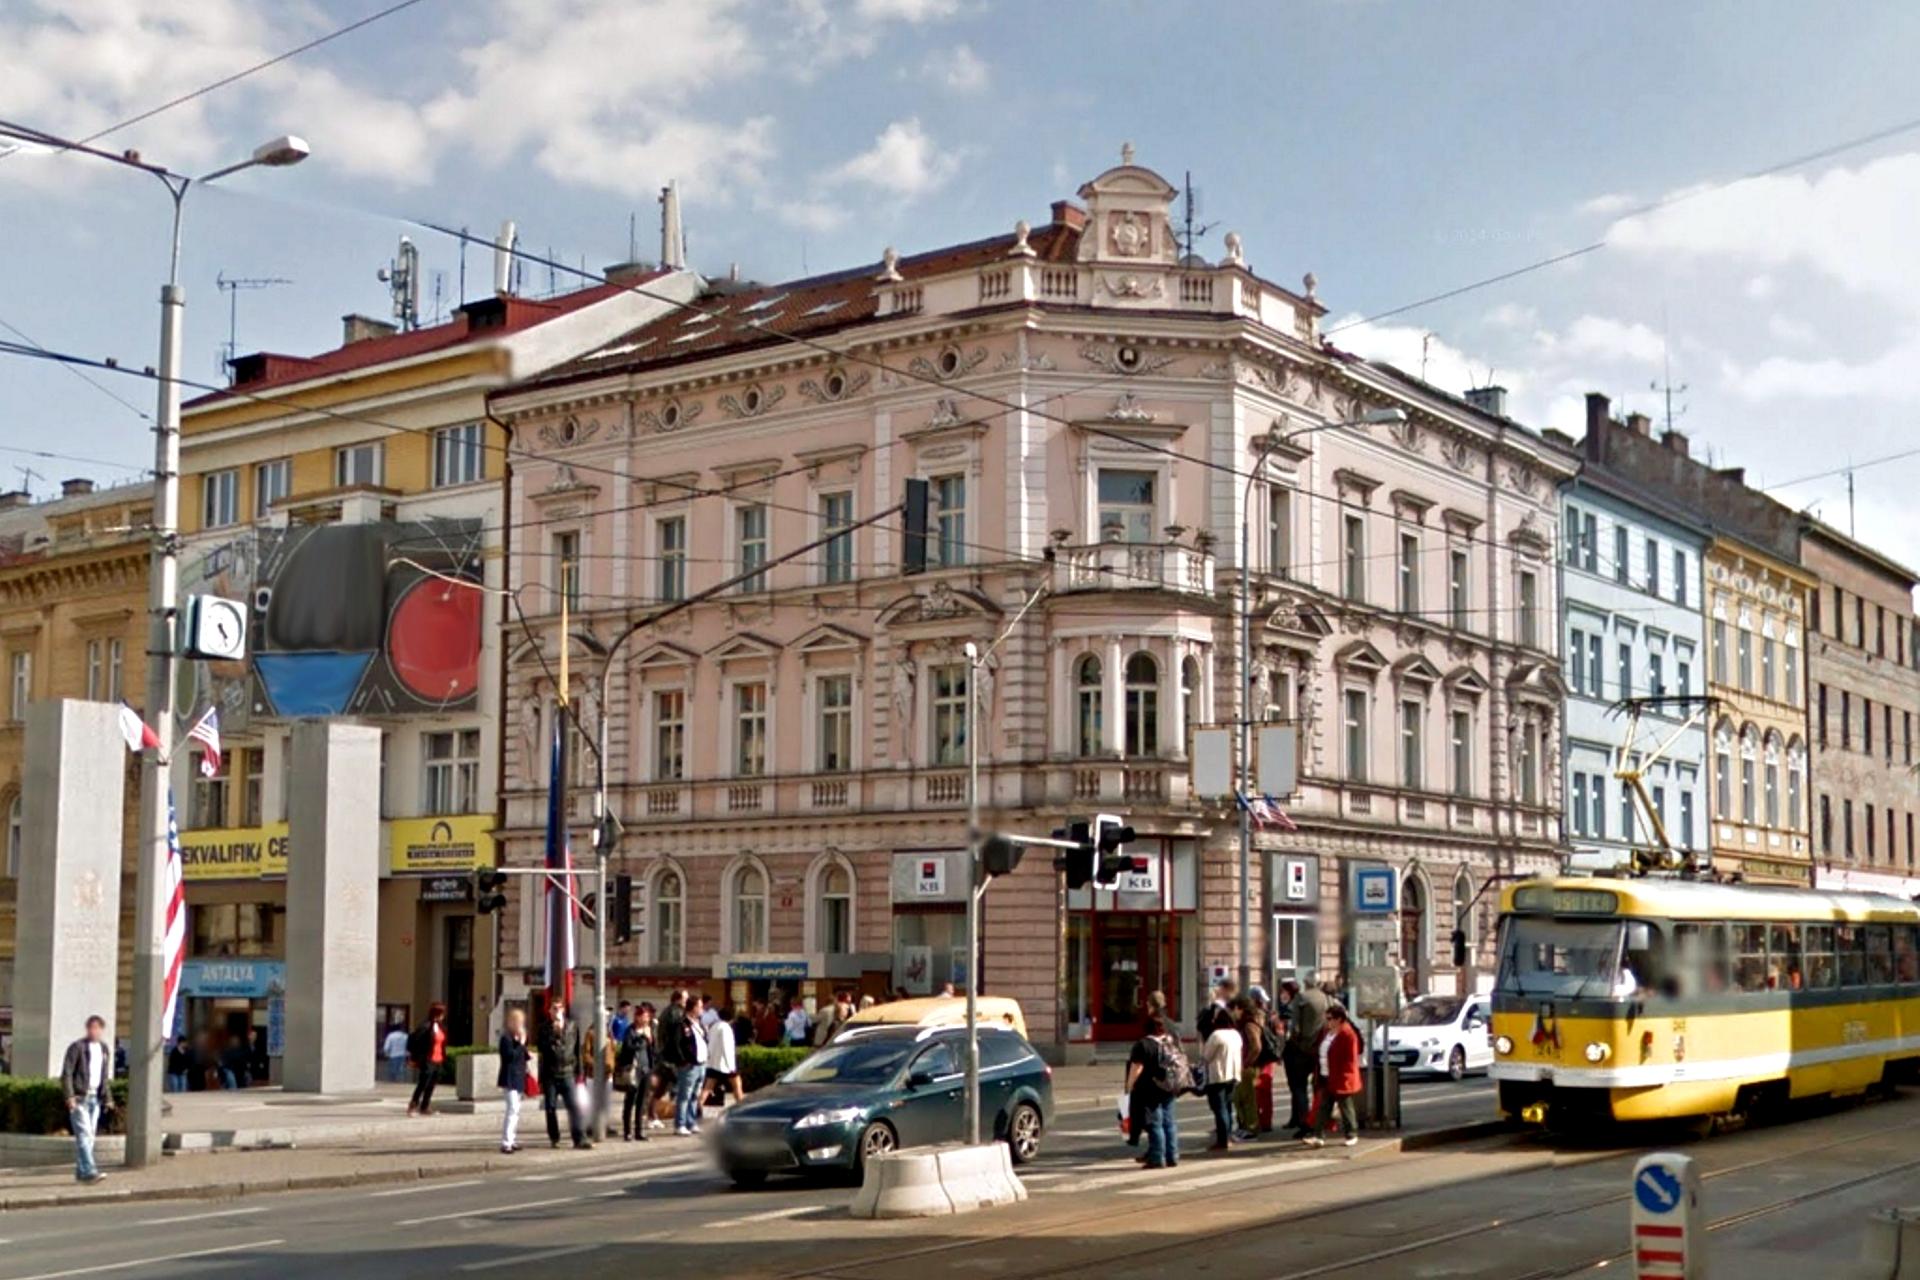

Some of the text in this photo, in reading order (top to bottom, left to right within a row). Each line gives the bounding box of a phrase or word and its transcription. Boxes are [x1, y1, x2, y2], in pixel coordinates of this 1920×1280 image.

[919, 882, 939, 892] KB
[1128, 877, 1152, 889] KB
[202, 964, 254, 982] ANTALYA
